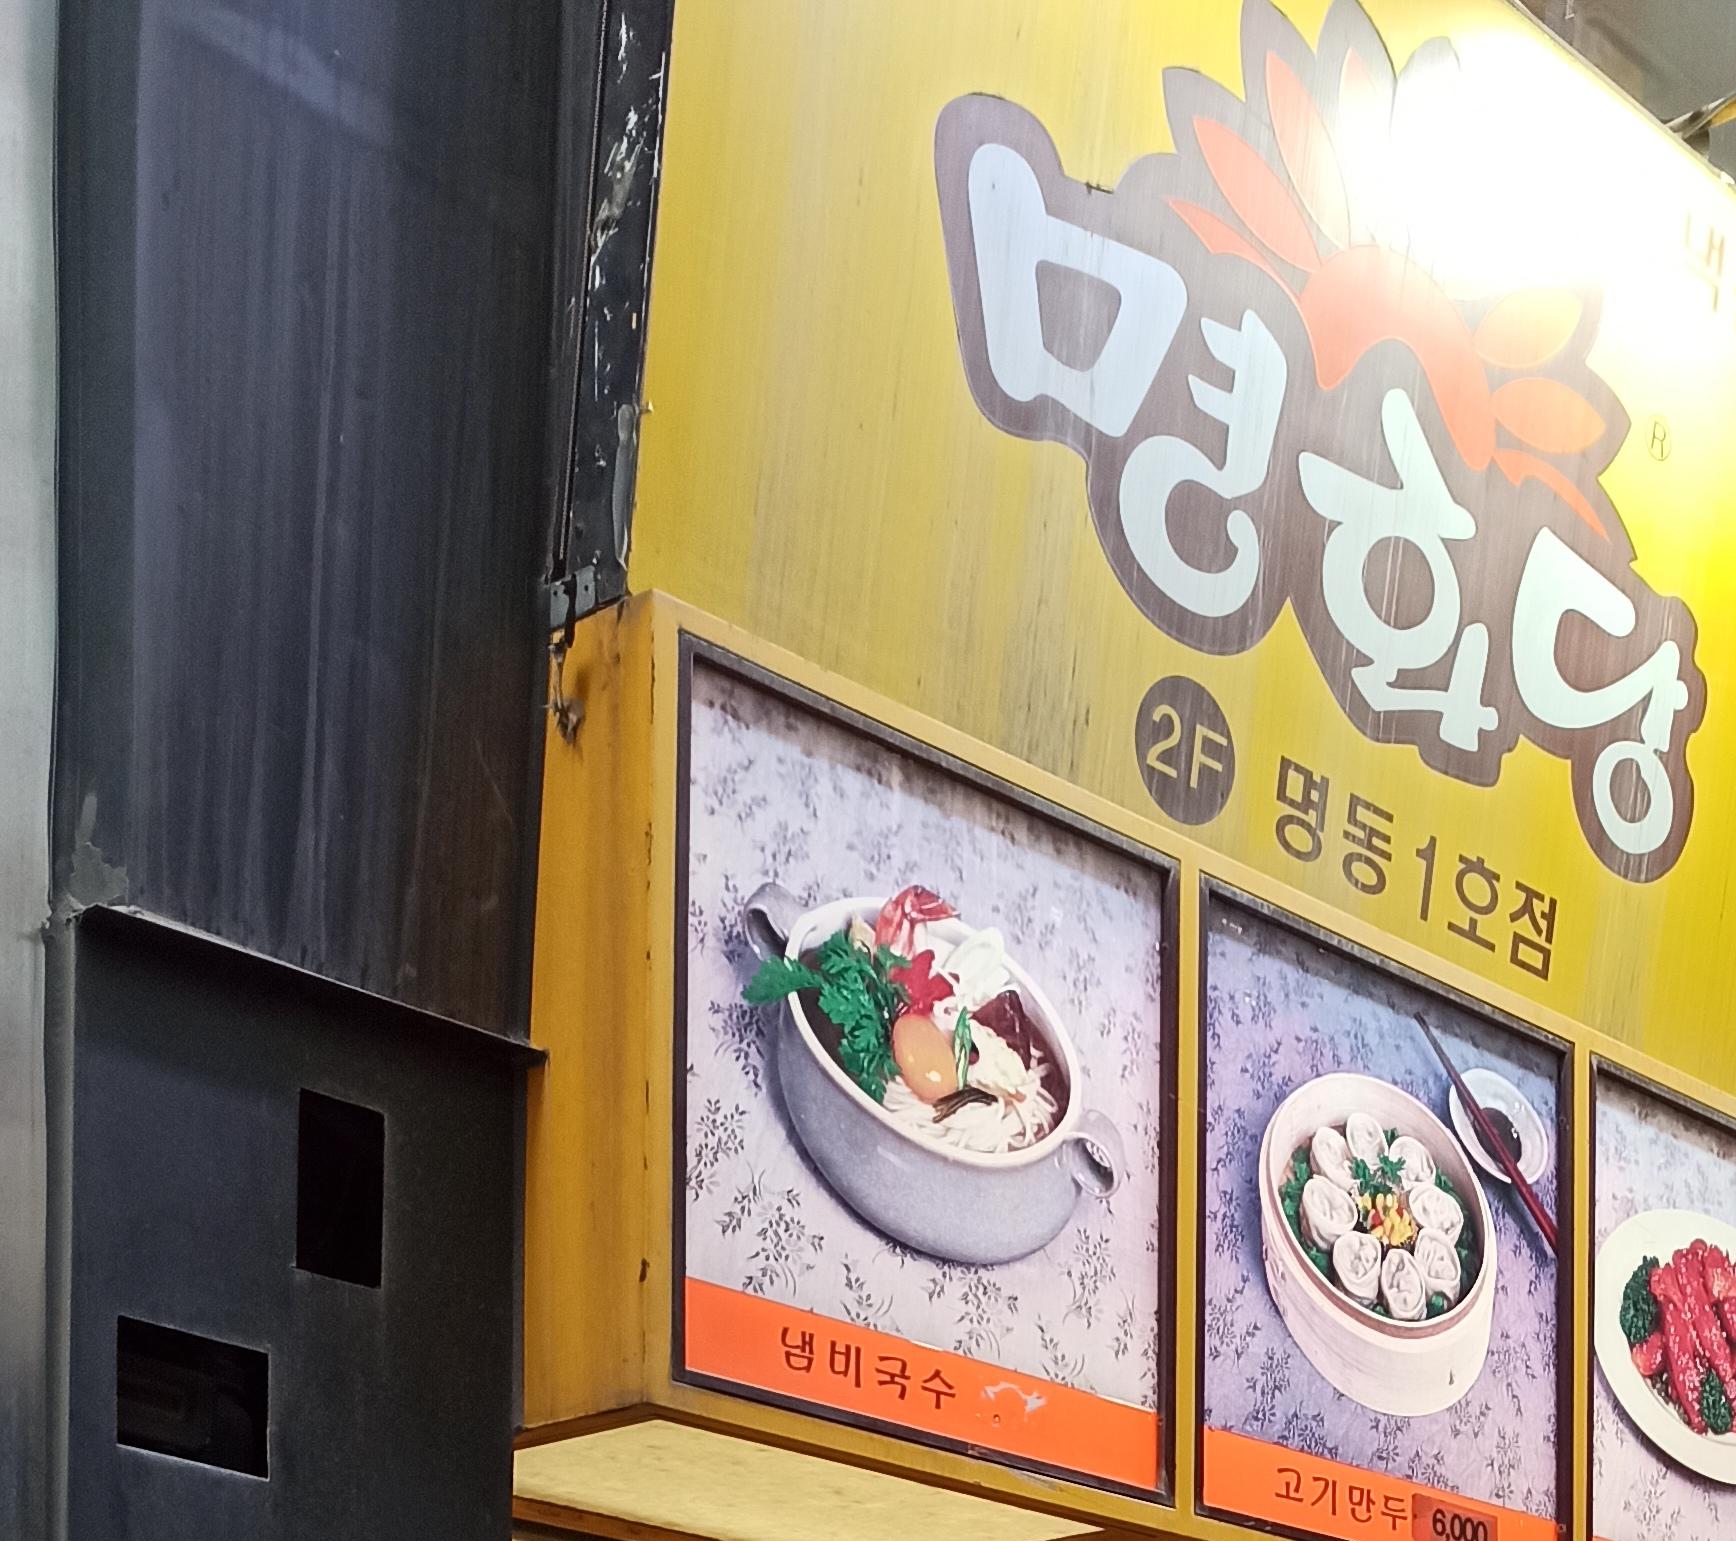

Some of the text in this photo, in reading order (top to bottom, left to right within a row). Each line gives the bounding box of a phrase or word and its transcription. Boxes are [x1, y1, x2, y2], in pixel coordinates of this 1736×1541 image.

[966, 142, 1688, 853] 명화당
[1146, 704, 1558, 980] 2F 명동1호점
[781, 1326, 956, 1409] 냄비국수
[1274, 1467, 1408, 1531] 고기만두
